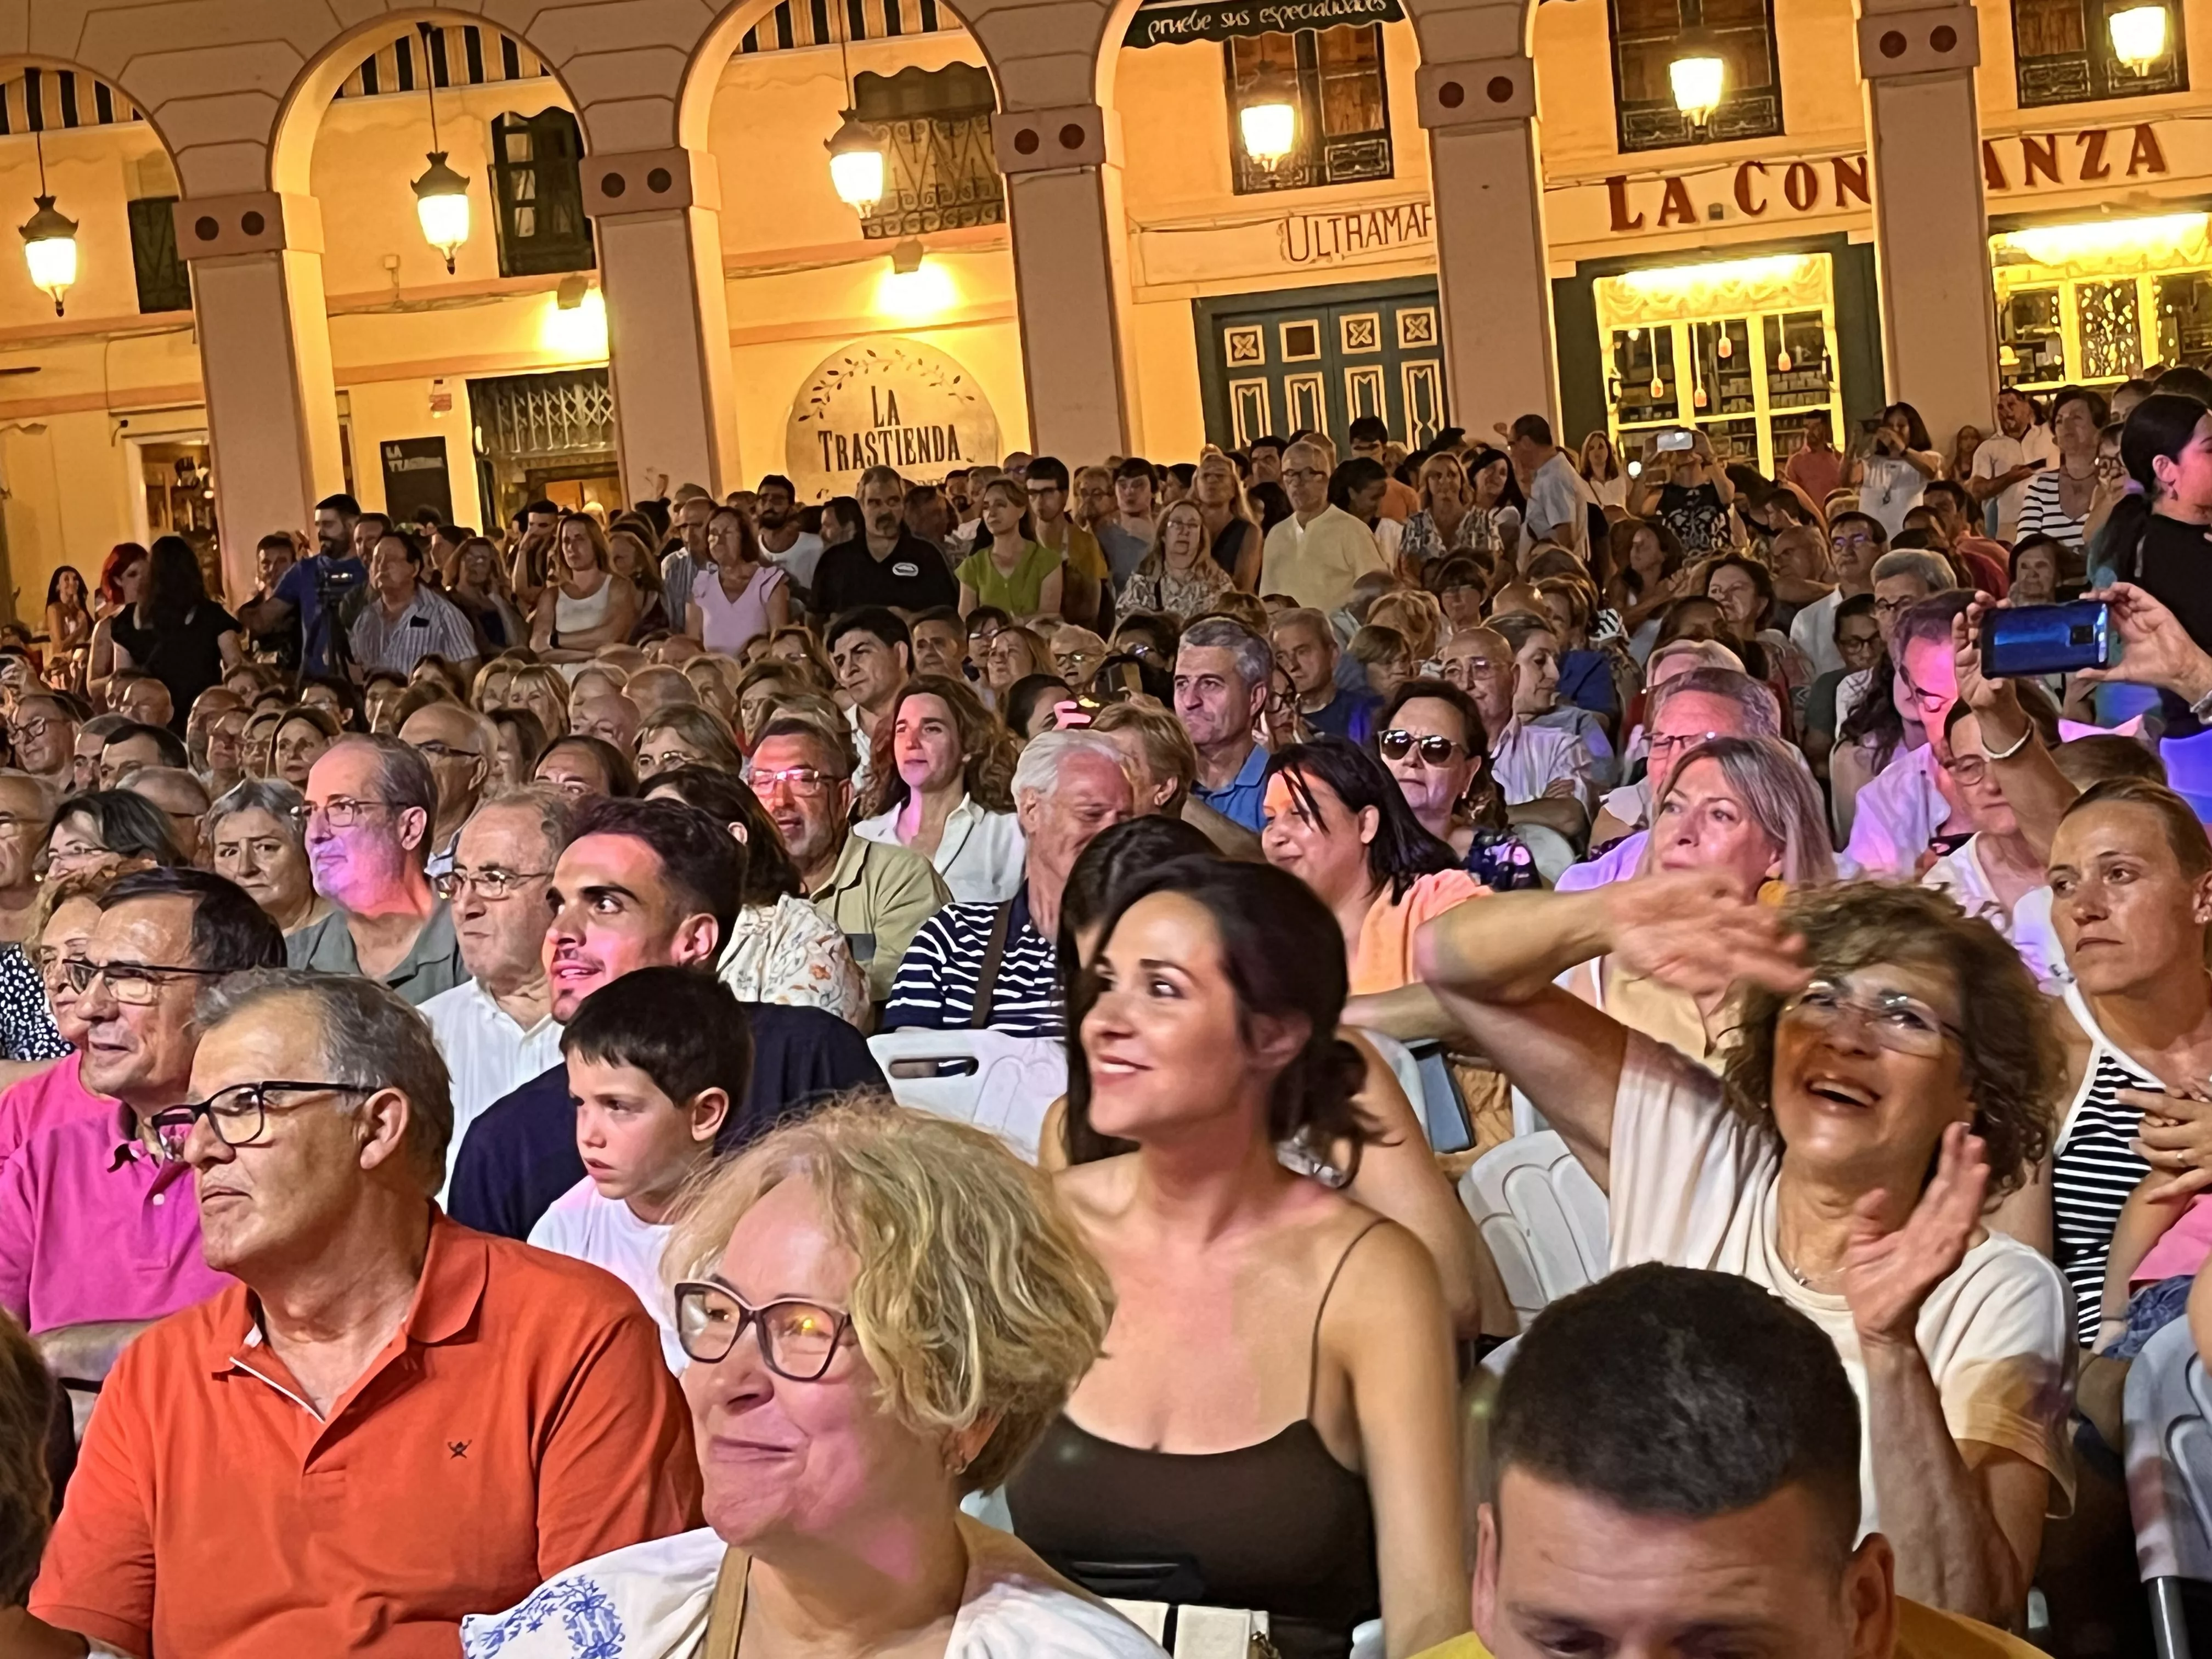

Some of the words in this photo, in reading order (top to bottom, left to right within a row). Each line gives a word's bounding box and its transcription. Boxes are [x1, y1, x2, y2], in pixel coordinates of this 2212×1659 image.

[1148, 9, 1211, 43] pruebe
[1220, 9, 1250, 29] sus
[1605, 175, 1696, 232] LA
[1734, 123, 2166, 216] CONANZA
[871, 385, 901, 428] LA
[817, 424, 961, 472] TRASTIENDA
